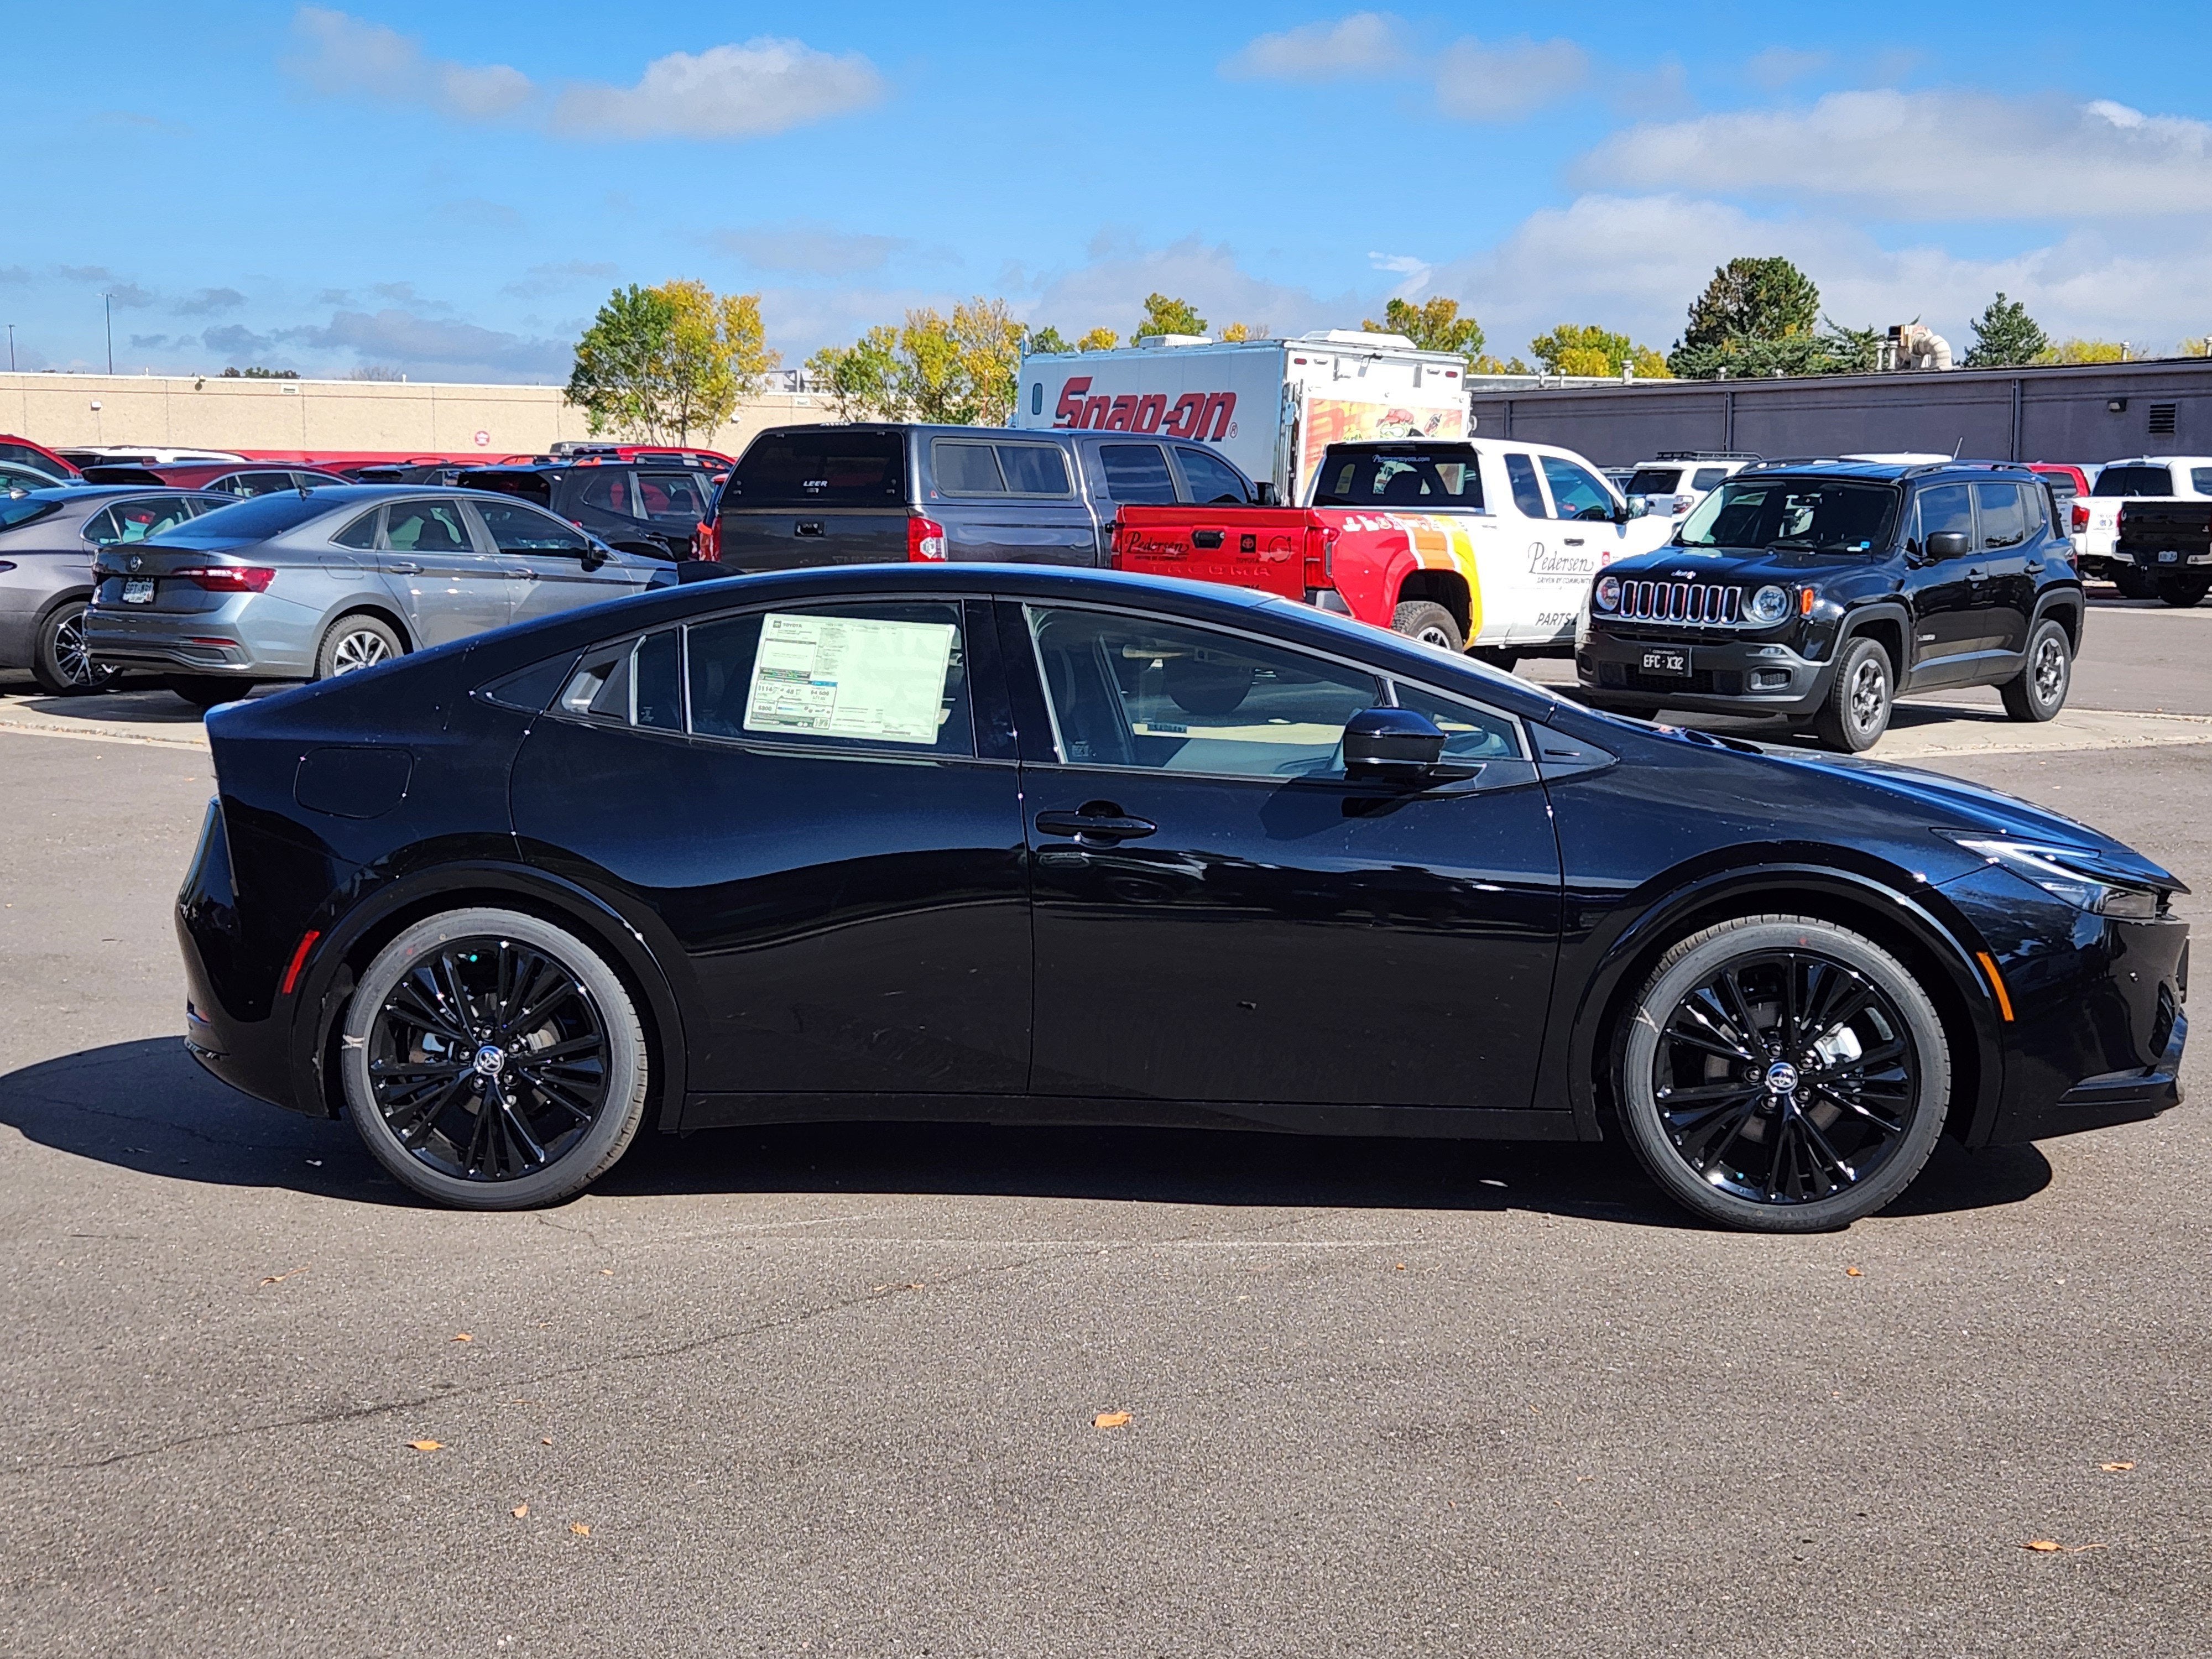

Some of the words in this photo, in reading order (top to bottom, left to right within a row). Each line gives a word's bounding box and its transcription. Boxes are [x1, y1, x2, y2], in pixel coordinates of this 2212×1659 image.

[1052, 376, 1237, 442] Snap-on
[1124, 531, 1190, 554] Pedersen
[1149, 562, 1271, 576] TACOMA
[1527, 541, 1594, 574] Pedersen
[1535, 612, 1572, 626] PARTS
